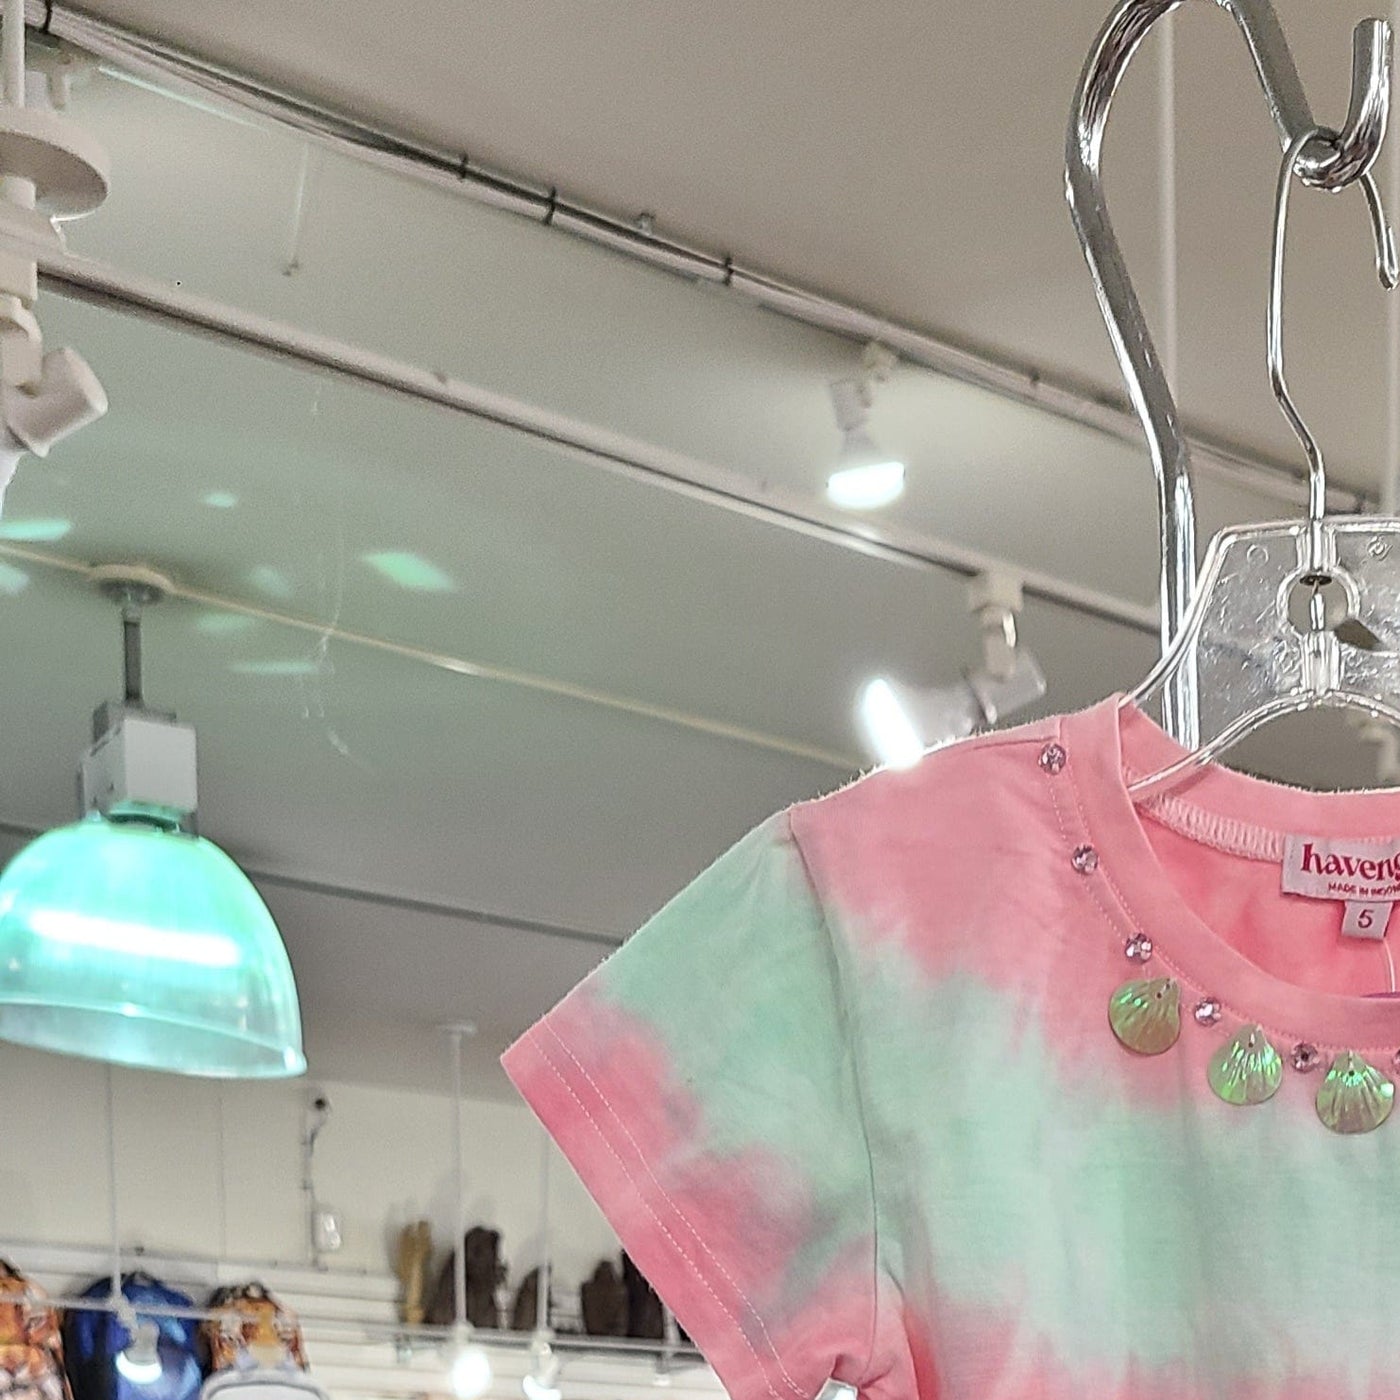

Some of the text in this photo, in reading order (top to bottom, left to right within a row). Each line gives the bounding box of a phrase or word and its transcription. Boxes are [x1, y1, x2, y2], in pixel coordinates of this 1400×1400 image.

[1328, 881, 1356, 893] MADE
[1359, 886, 1369, 896] IN
[1357, 909, 1374, 929] 5
